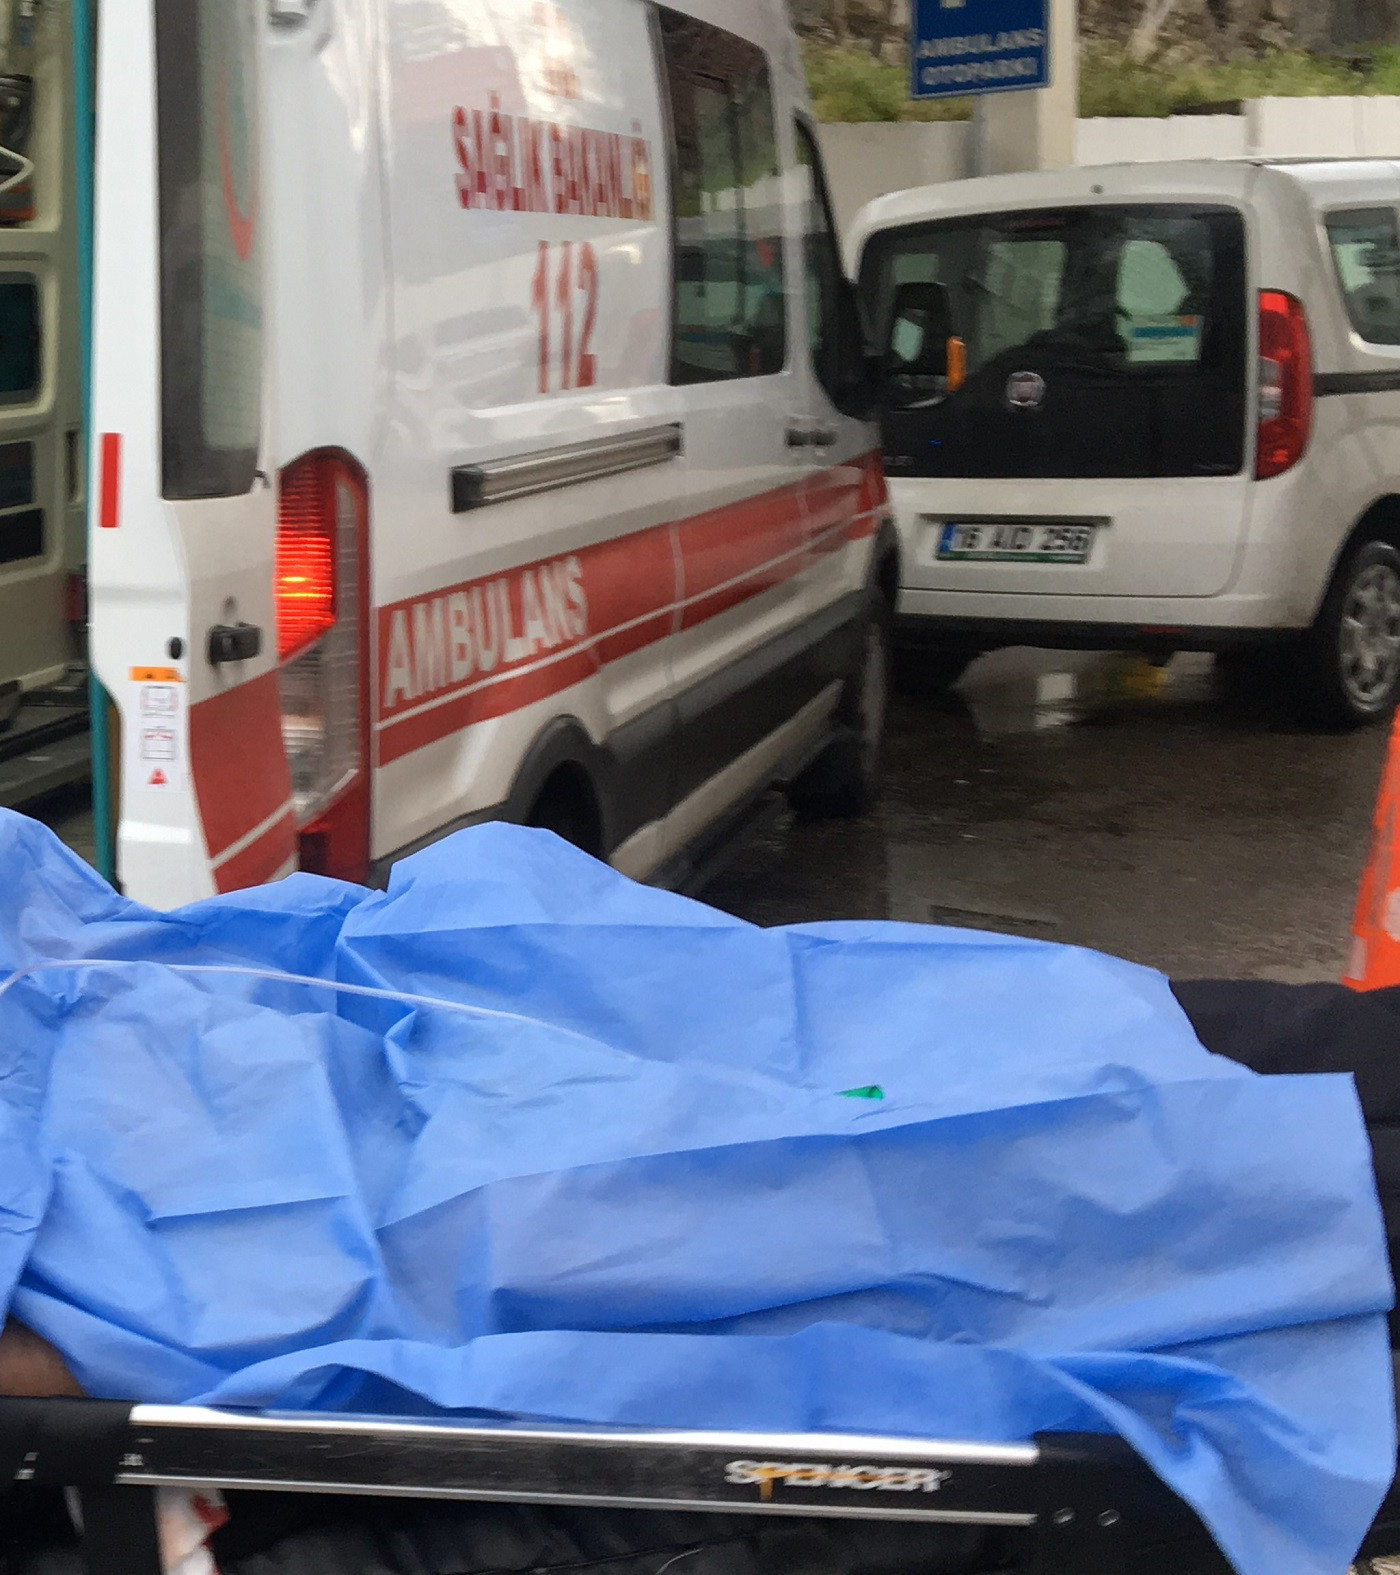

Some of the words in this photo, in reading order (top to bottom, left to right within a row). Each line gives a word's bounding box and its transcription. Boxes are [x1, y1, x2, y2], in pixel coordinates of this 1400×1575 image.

[452, 90, 549, 211] SAĞLIK
[531, 240, 598, 394] 112
[384, 556, 587, 708] AMBULANS
[724, 1460, 952, 1500] SPENCER
